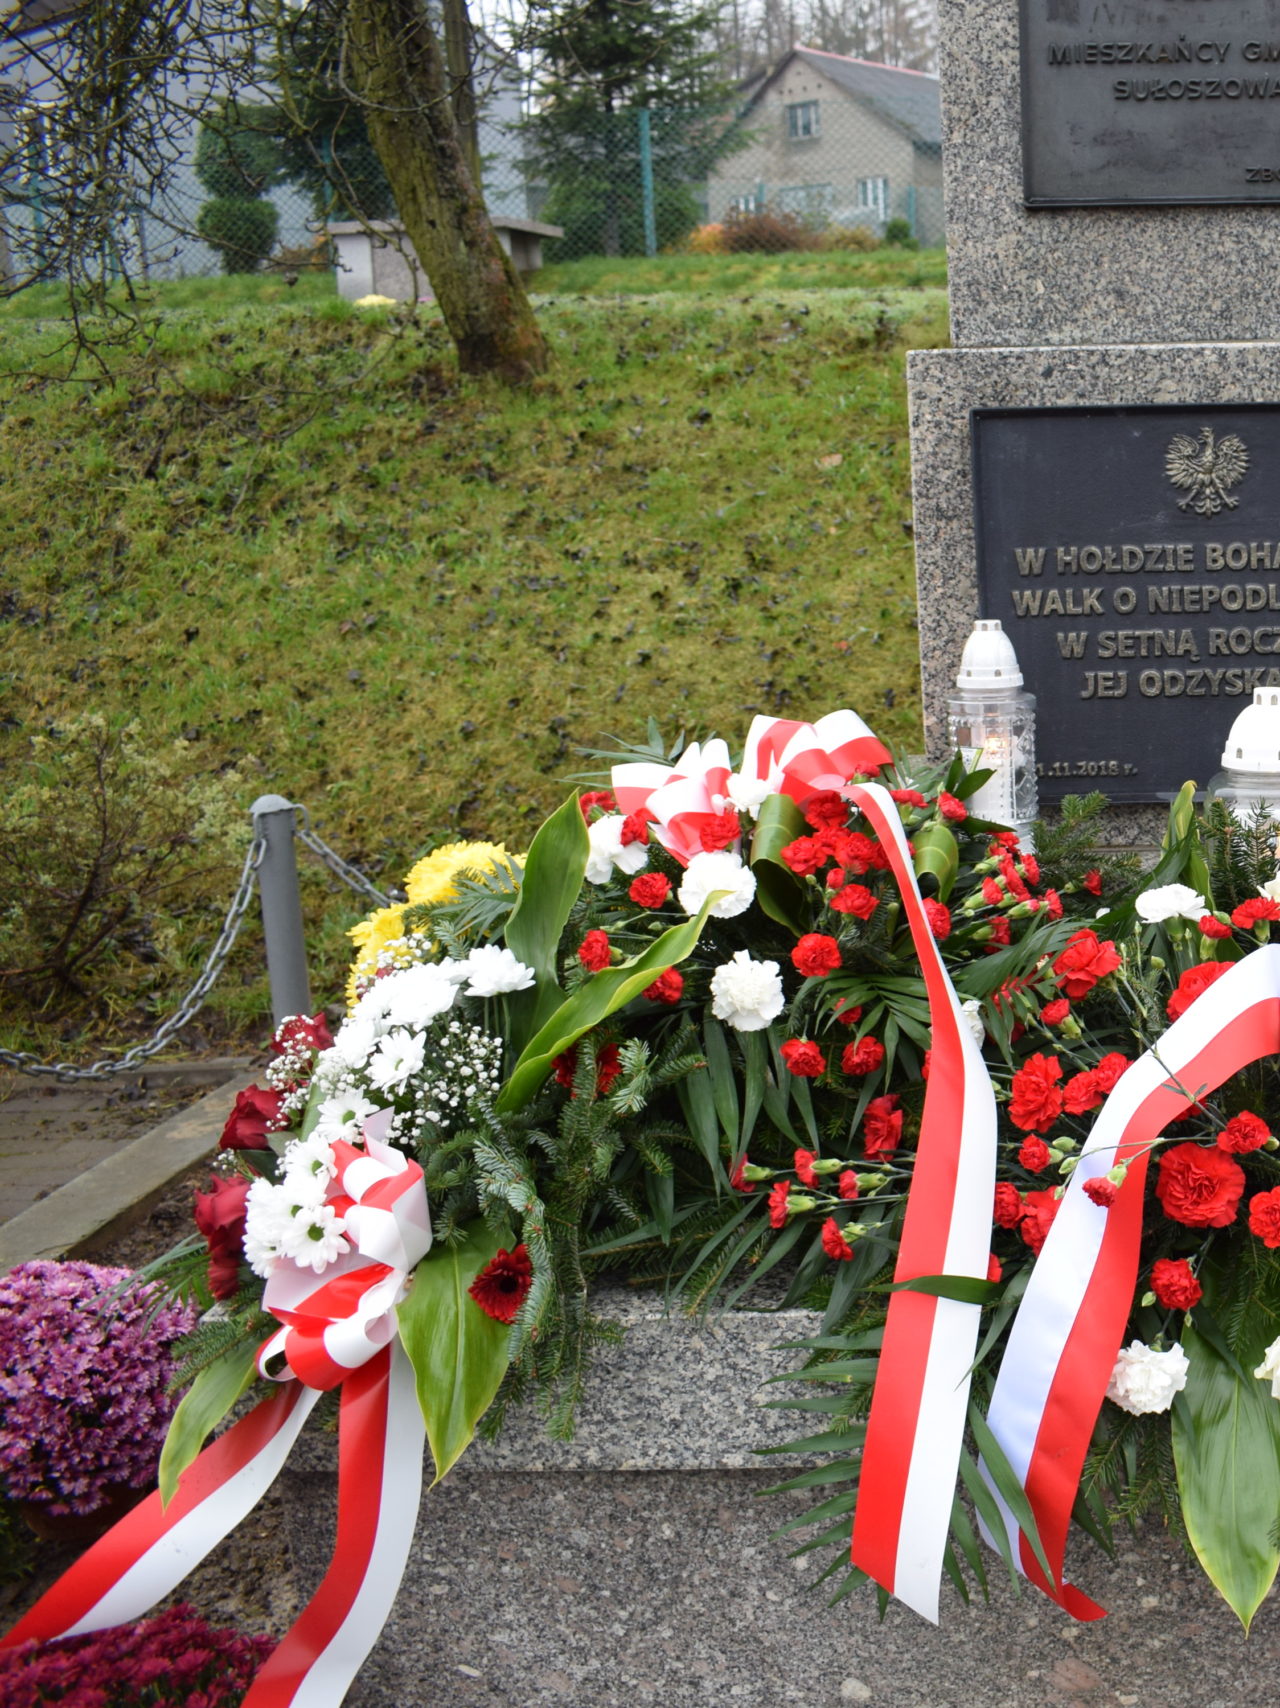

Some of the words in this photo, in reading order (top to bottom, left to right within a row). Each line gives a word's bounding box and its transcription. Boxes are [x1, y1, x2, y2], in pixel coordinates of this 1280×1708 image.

[1048, 34, 1231, 65] MIESZKAŃCY
[1014, 547, 1045, 576] W
[1056, 544, 1194, 574] HOŁDZIE
[1011, 587, 1104, 617] WALK
[1113, 586, 1137, 614] O
[1057, 631, 1088, 659] W
[1098, 629, 1199, 662] SETNĄ
[1080, 670, 1128, 699] JEJ
[1036, 760, 1120, 777] 1.11.2018
